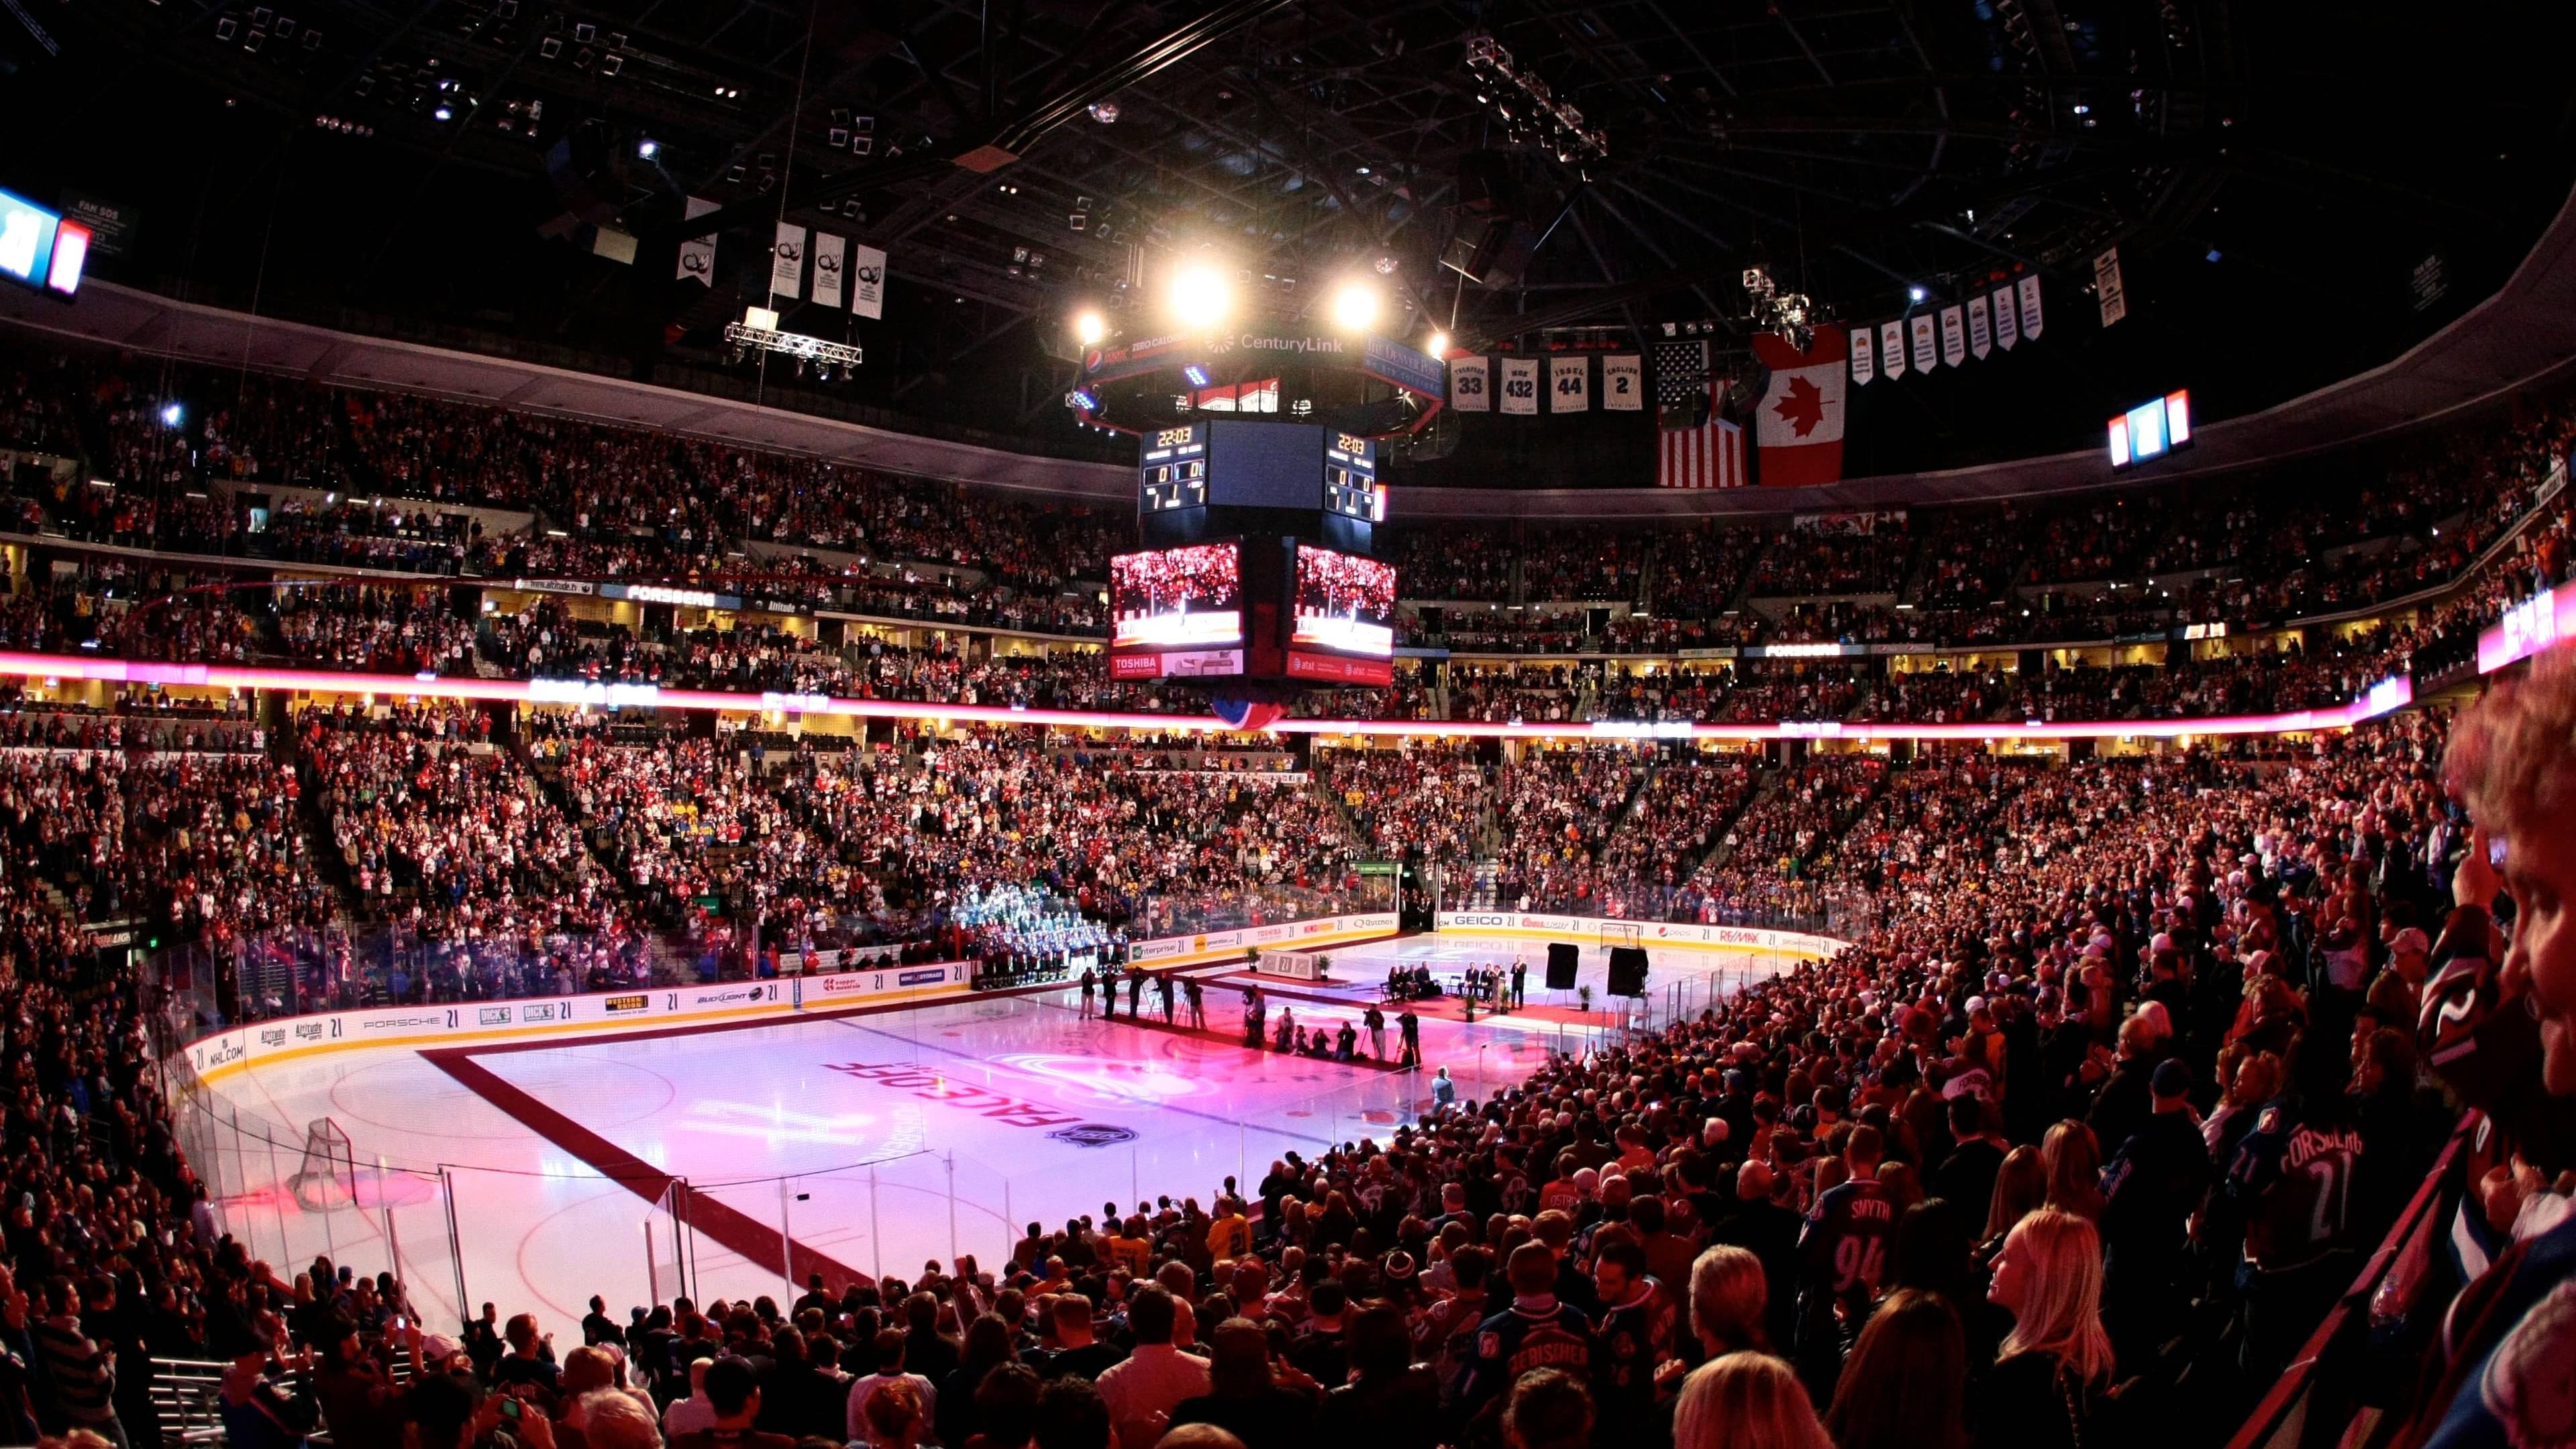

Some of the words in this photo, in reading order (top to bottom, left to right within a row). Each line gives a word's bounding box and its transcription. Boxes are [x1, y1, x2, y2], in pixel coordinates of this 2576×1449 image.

[1132, 341, 1151, 352] ZERO
[1241, 334, 1342, 354] CenturyLink
[1555, 367, 1584, 377] ISSEL
[1458, 377, 1482, 395] 33
[1506, 380, 1533, 398] 432
[1557, 377, 1582, 395] 44
[1616, 377, 1629, 394] 2
[1157, 428, 1192, 448] 22:03
[1338, 434, 1364, 455] 22:03
[1159, 467, 1168, 483] 0
[1339, 470, 1347, 485] 0
[1363, 478, 1370, 492] 0
[627, 585, 715, 607] FORSBERG
[768, 601, 796, 613] Altitude
[1116, 658, 1156, 668] TOSHIBA
[1455, 916, 1502, 926] GEICO
[1507, 916, 1514, 927] 21
[1572, 919, 1579, 931] 21
[1237, 933, 1242, 945] 21
[1257, 928, 1281, 938] TOSHIBA
[1288, 926, 1294, 938] 21
[1702, 929, 1710, 940] 21
[1720, 930, 1760, 944] RE/MAX
[1768, 934, 1775, 945] 21
[1178, 940, 1184, 953] 21
[1823, 941, 1830, 952] 21
[1282, 958, 1290, 970] 21
[954, 966, 962, 981] 21
[875, 974, 883, 989] 21
[720, 993, 747, 1001] LIGHT
[768, 984, 777, 1001] 21
[606, 996, 641, 1005] WESTERN
[668, 993, 678, 1010] 21
[560, 1001, 571, 1019] 21
[364, 1017, 440, 1028] PORSCHE
[447, 1009, 458, 1028] 21
[261, 1028, 286, 1041] Altitude
[295, 1021, 323, 1034] Altitude
[331, 1017, 342, 1038] 21
[197, 1047, 204, 1070] 21
[210, 1045, 244, 1068] NHL.COM
[2308, 1150, 2353, 1244] 21
[1851, 1199, 1891, 1222] SMYTH
[1834, 1234, 1887, 1293] 94
